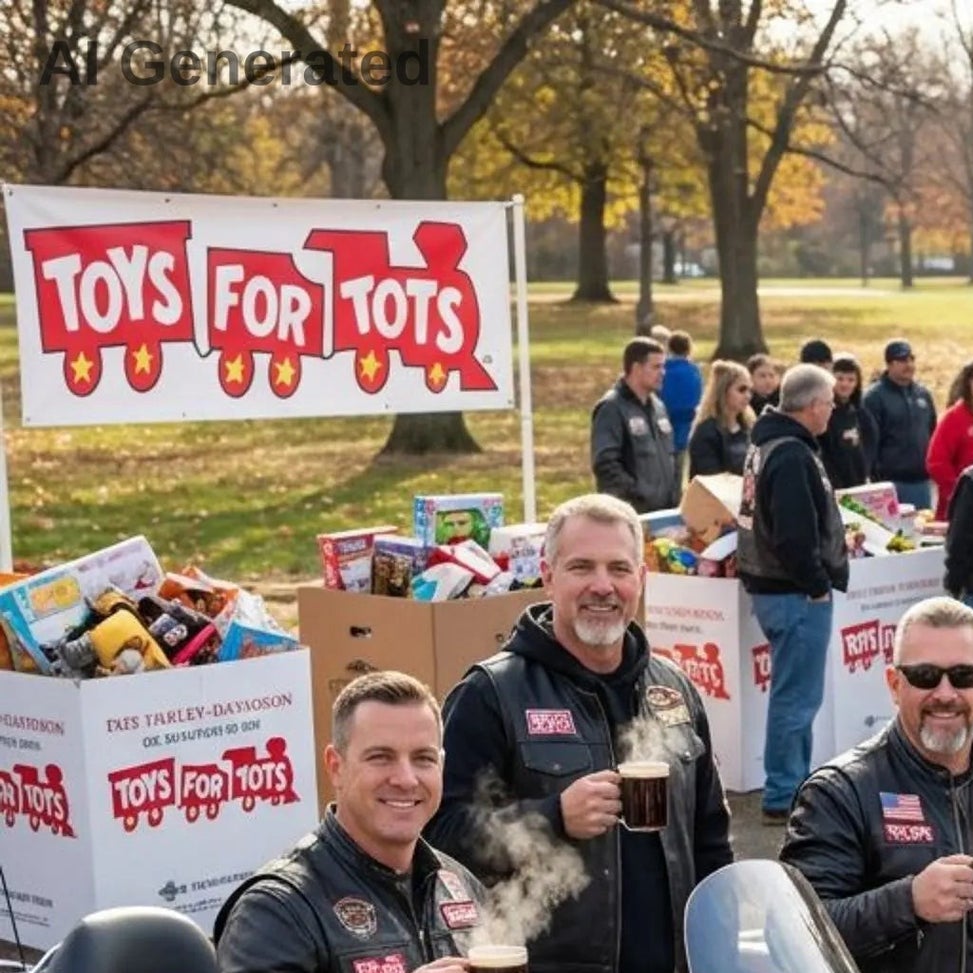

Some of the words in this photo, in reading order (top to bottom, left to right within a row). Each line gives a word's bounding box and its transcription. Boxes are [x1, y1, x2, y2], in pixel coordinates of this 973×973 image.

[41, 245, 183, 334] TOYS
[213, 264, 312, 346] FOR
[340, 274, 463, 354] TOTS
[23, 784, 65, 821] TOTS
[114, 769, 172, 810] TOYS
[183, 770, 223, 799] FOR
